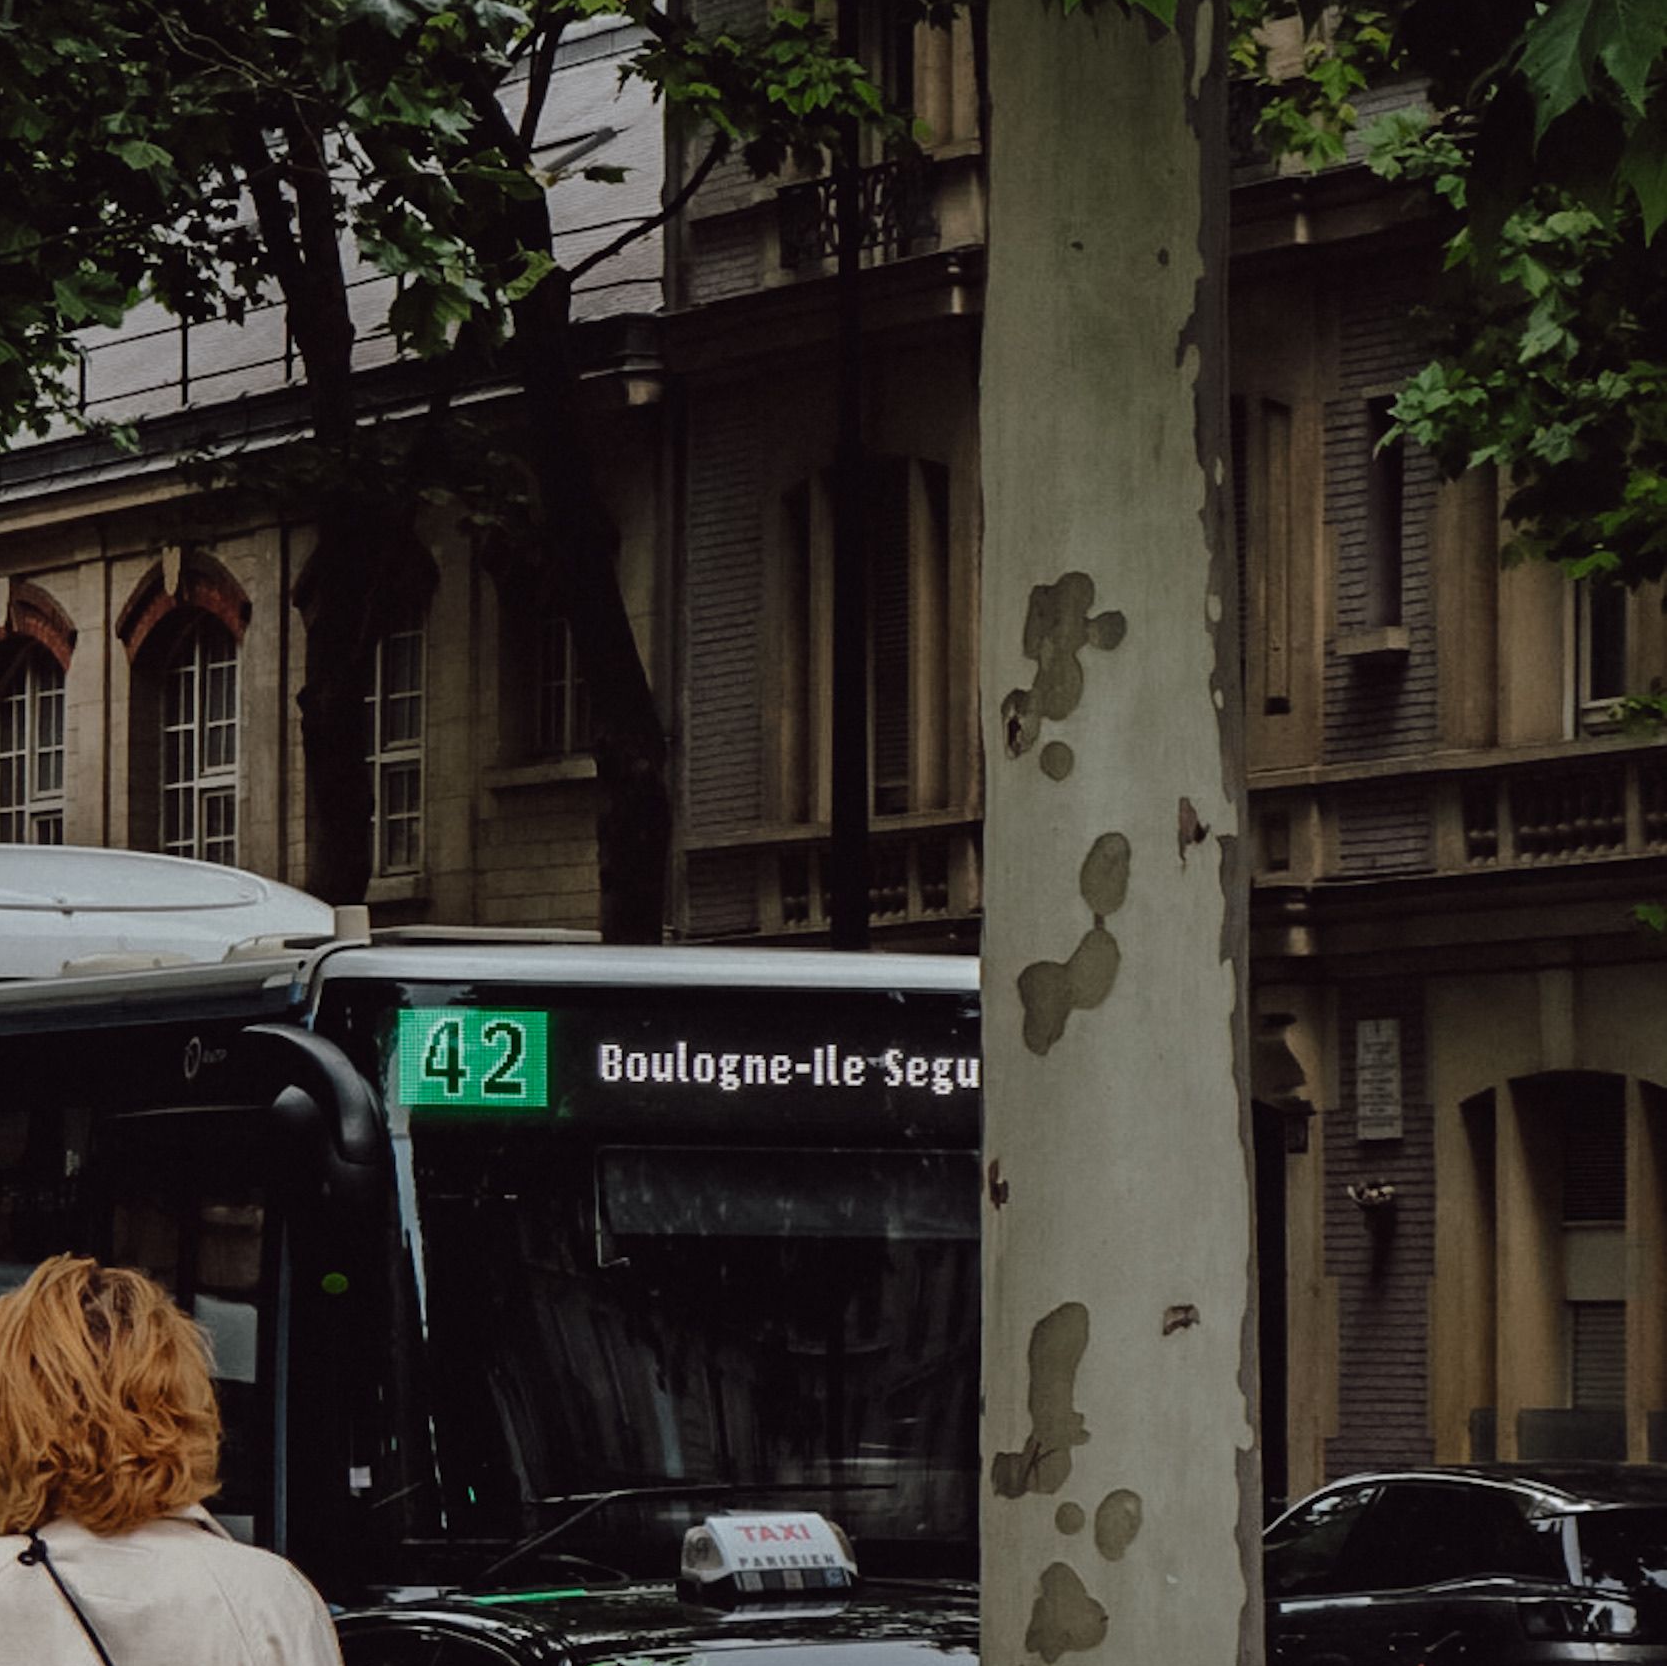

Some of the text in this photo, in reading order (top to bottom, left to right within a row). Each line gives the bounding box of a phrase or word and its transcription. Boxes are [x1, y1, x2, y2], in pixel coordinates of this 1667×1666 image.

[423, 1019, 526, 1096] 42
[598, 1039, 981, 1095] Boulogne-Ile Segu
[736, 1523, 811, 1542] TAXI
[738, 1554, 835, 1568] PARISIEN
